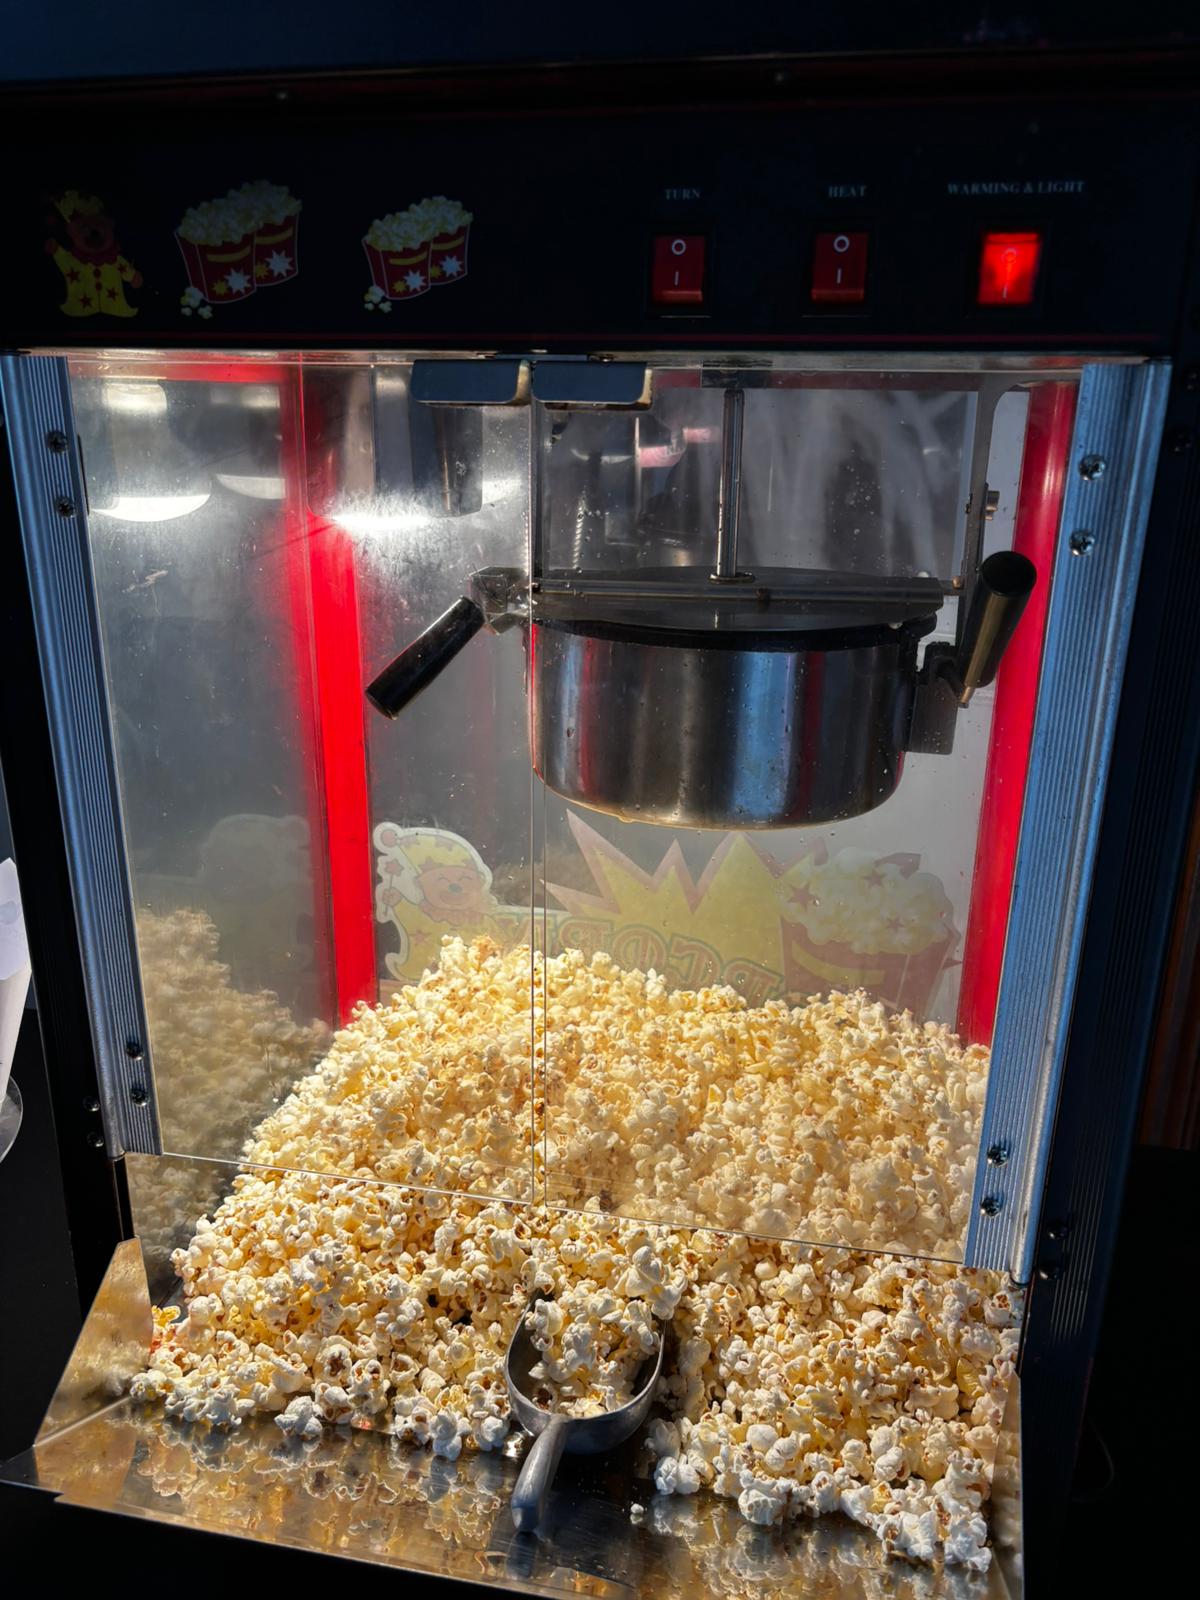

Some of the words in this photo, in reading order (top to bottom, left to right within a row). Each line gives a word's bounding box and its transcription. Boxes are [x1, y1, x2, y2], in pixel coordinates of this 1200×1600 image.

[664, 188, 701, 200] TURN
[827, 185, 867, 198] HEAT
[947, 182, 1020, 195] WARMING
[1023, 181, 1033, 193] &
[1037, 180, 1085, 193] LIGHT
